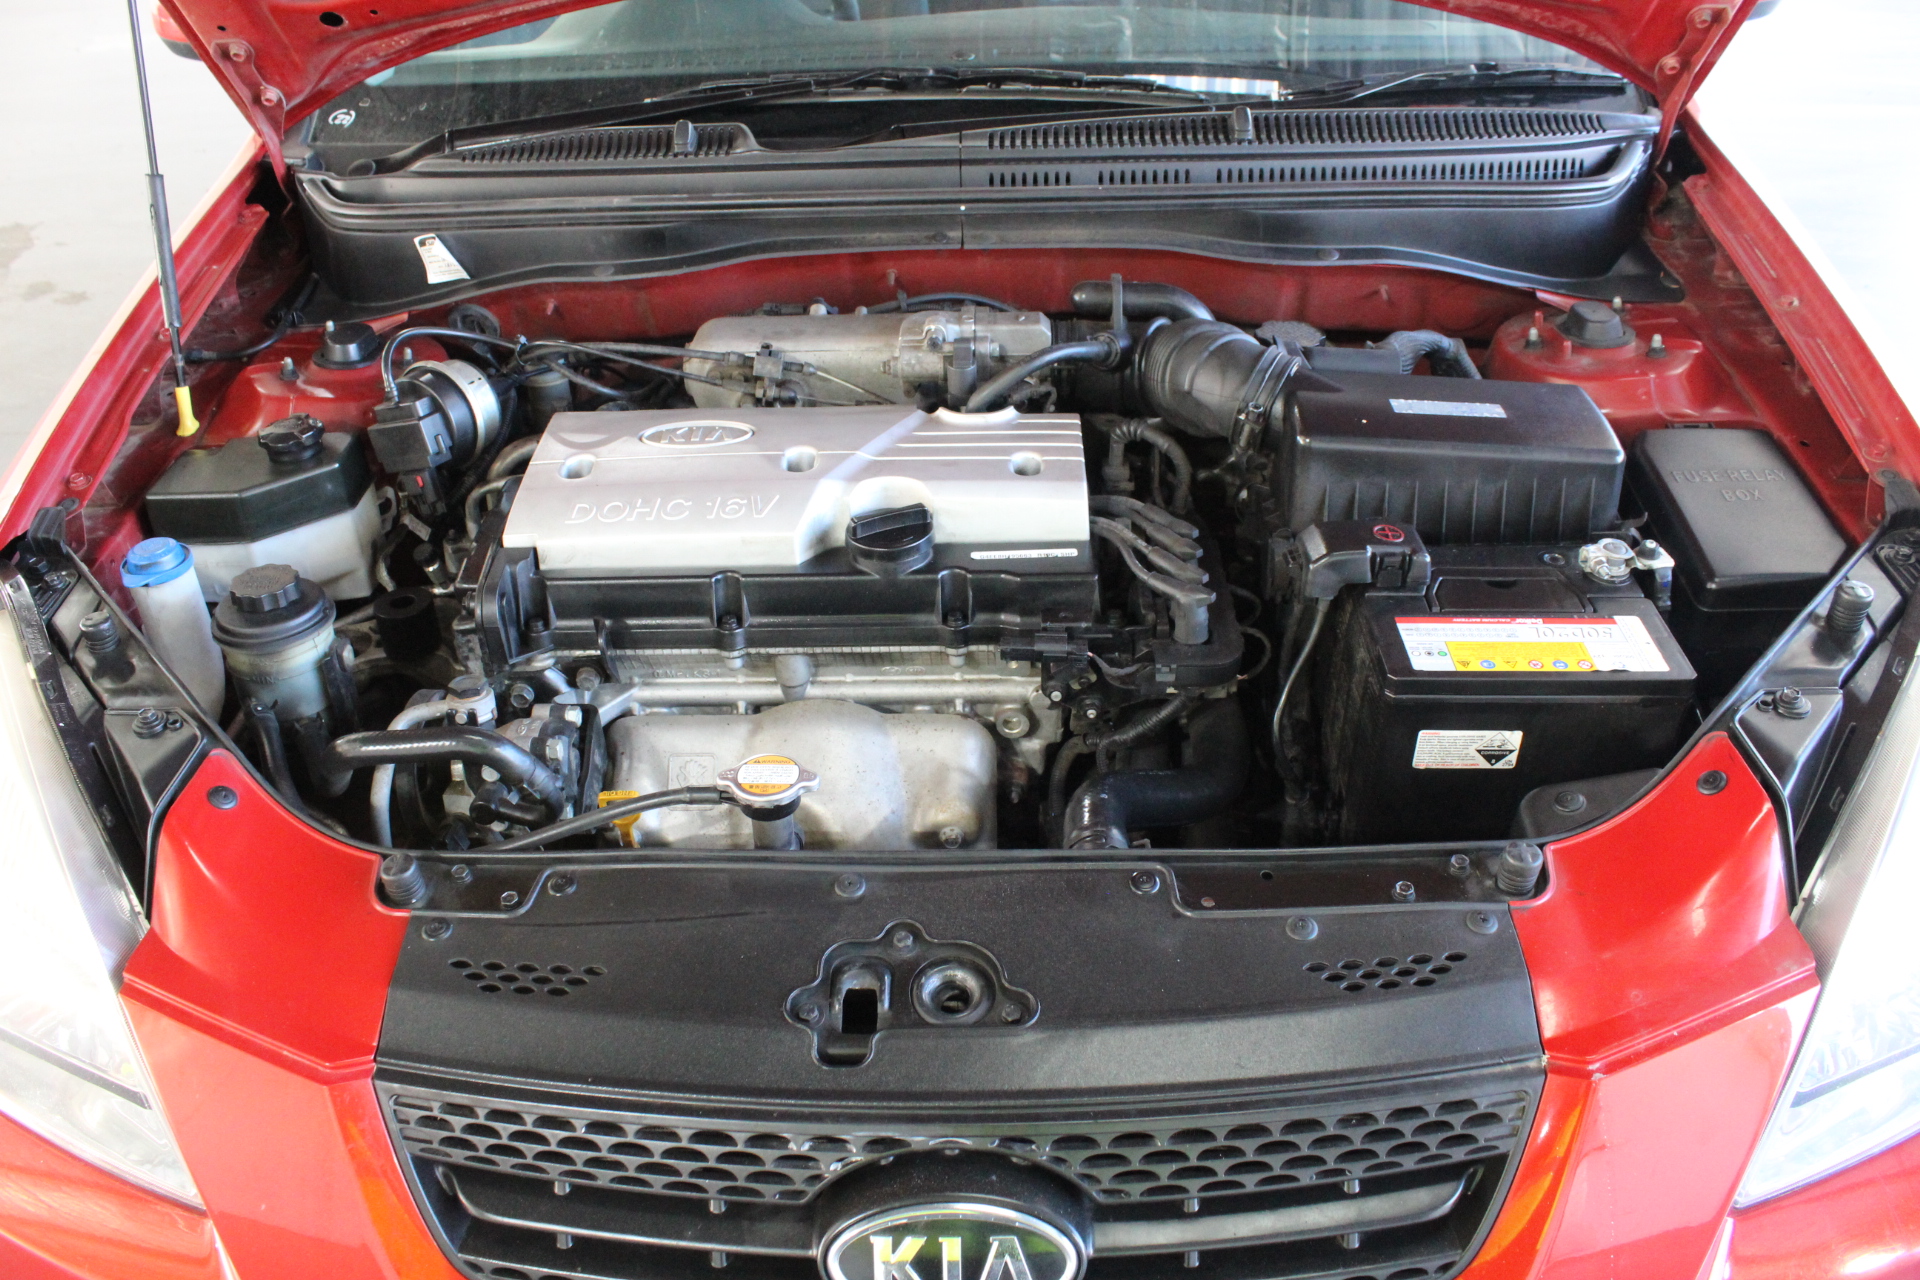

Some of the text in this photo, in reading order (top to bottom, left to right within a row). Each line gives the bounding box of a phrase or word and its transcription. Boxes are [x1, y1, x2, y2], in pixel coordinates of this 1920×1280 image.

[660, 426, 734, 443] KIA
[1671, 469, 1787, 483] FUSE RELAY
[1721, 488, 1764, 502] BOX
[565, 493, 780, 523] DOHC 16V
[1528, 626, 1613, 639] 50D20L
[869, 1235, 1033, 1280] KIA
